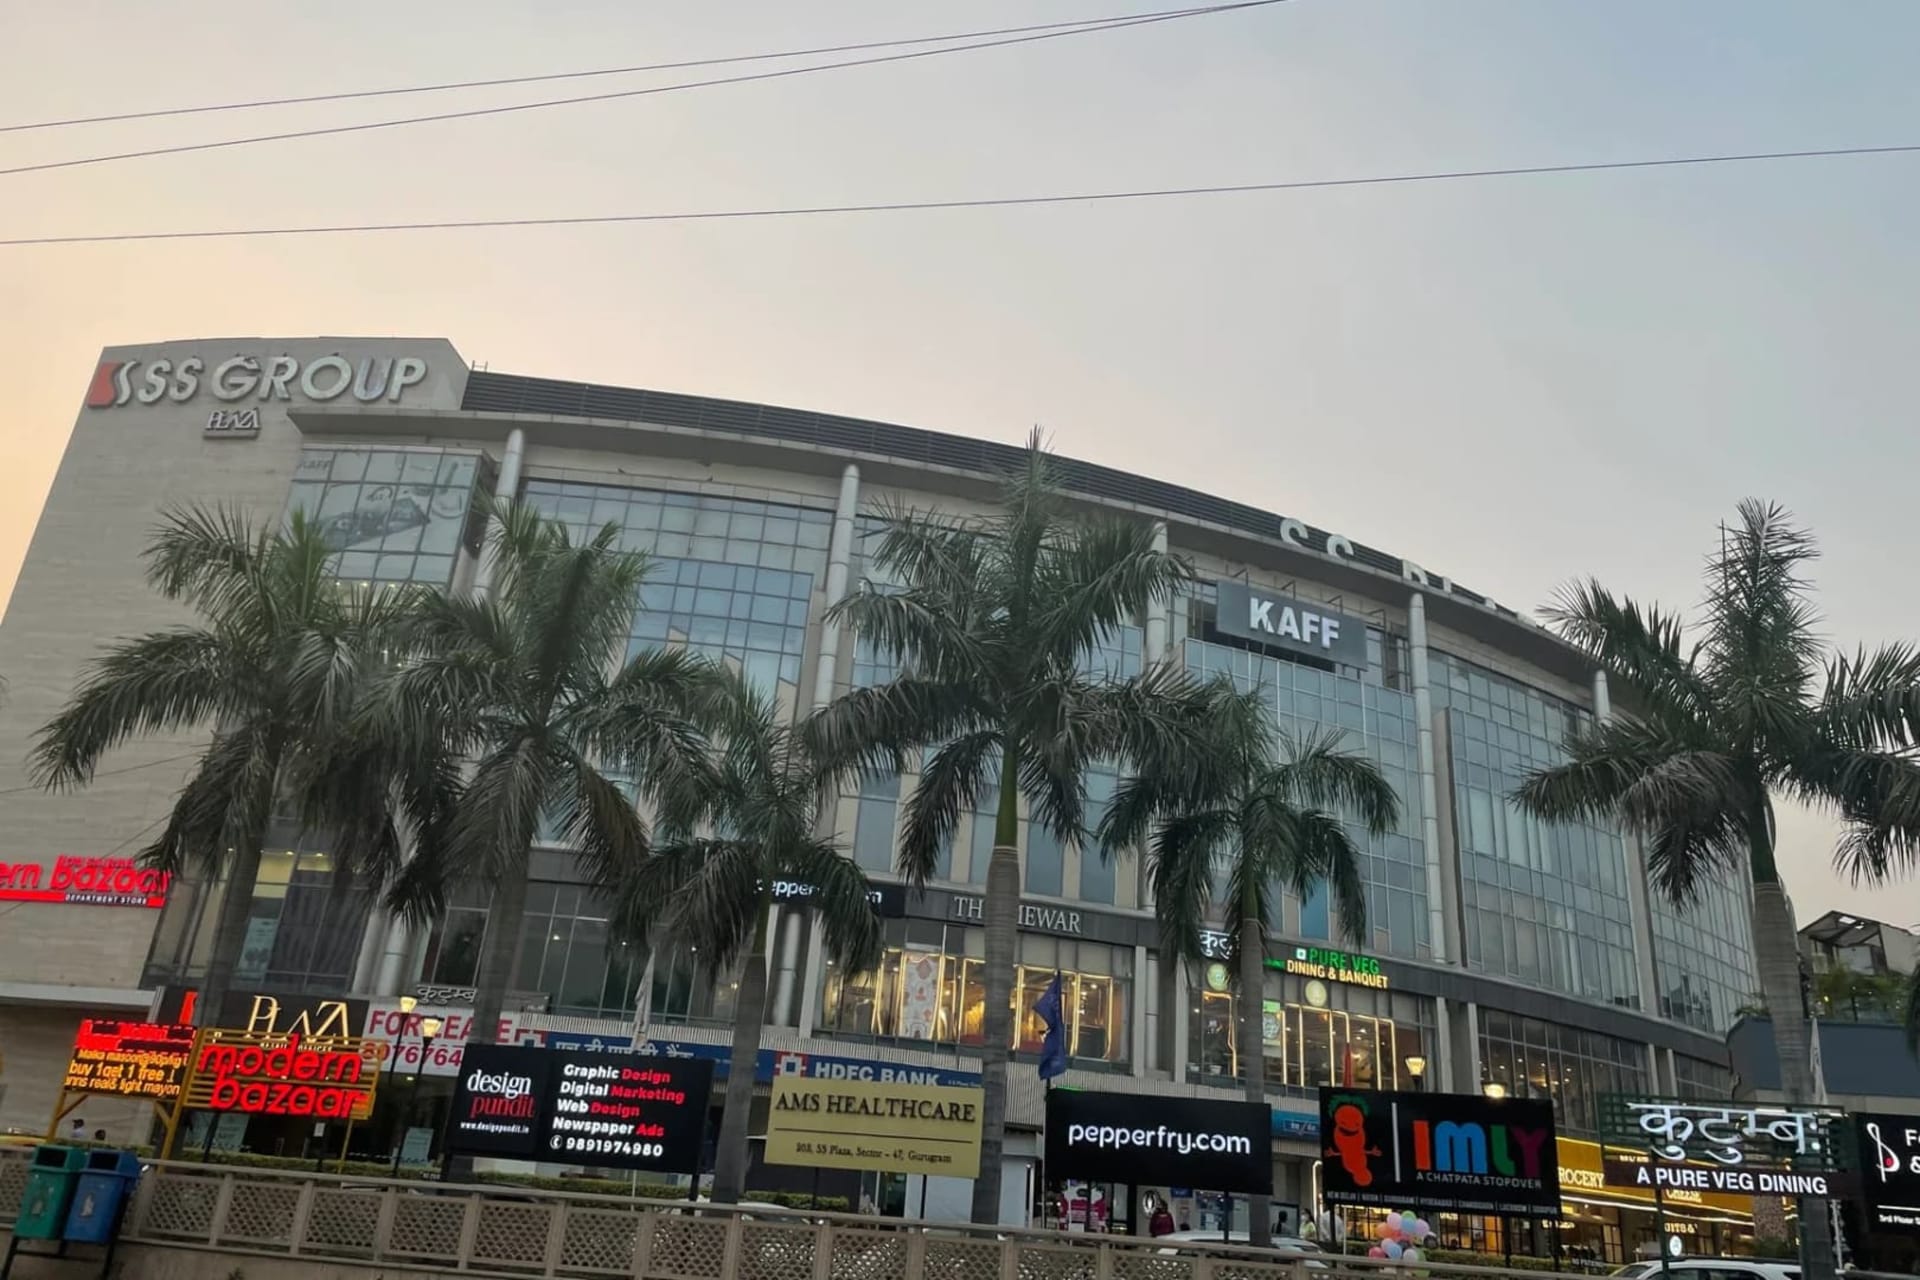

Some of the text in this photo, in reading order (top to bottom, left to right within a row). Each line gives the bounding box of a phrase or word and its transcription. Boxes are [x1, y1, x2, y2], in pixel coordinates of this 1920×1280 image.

[211, 355, 427, 401] GROUP
[205, 408, 260, 430] PLAZA
[1250, 596, 1340, 649] KAFF
[65, 893, 148, 906] DEPARTMENT STORE
[954, 896, 984, 919] TH
[1286, 959, 1326, 979] DINING
[1328, 967, 1337, 980] &
[1339, 968, 1389, 989] BANQUET
[1309, 947, 1347, 969] PURE
[1351, 954, 1380, 975] VEG
[243, 994, 350, 1046] PLAZA
[369, 1010, 422, 1038] FOR
[198, 1033, 363, 1083] modern
[137, 1066, 165, 1081] free
[467, 1068, 532, 1100] design
[563, 1063, 672, 1085] Graphic Design
[815, 1061, 874, 1082] HDFC
[879, 1067, 941, 1087] BANK
[209, 1064, 369, 1118] bazaar
[560, 1080, 686, 1105] Digital Marketing
[470, 1094, 536, 1119] pundit
[556, 1098, 641, 1119] Web Design
[775, 1092, 976, 1123] AMS HEALTHCARE
[552, 1116, 665, 1138] Newspaper Ads
[1068, 1123, 1252, 1156] pepperfry.com
[565, 1137, 664, 1158] 9891974980
[1416, 1172, 1542, 1189] A CHATPATA STOPOVER
[1557, 1166, 1605, 1188] ROCERY
[1636, 1166, 1828, 1195] A PURE VEG DINING
